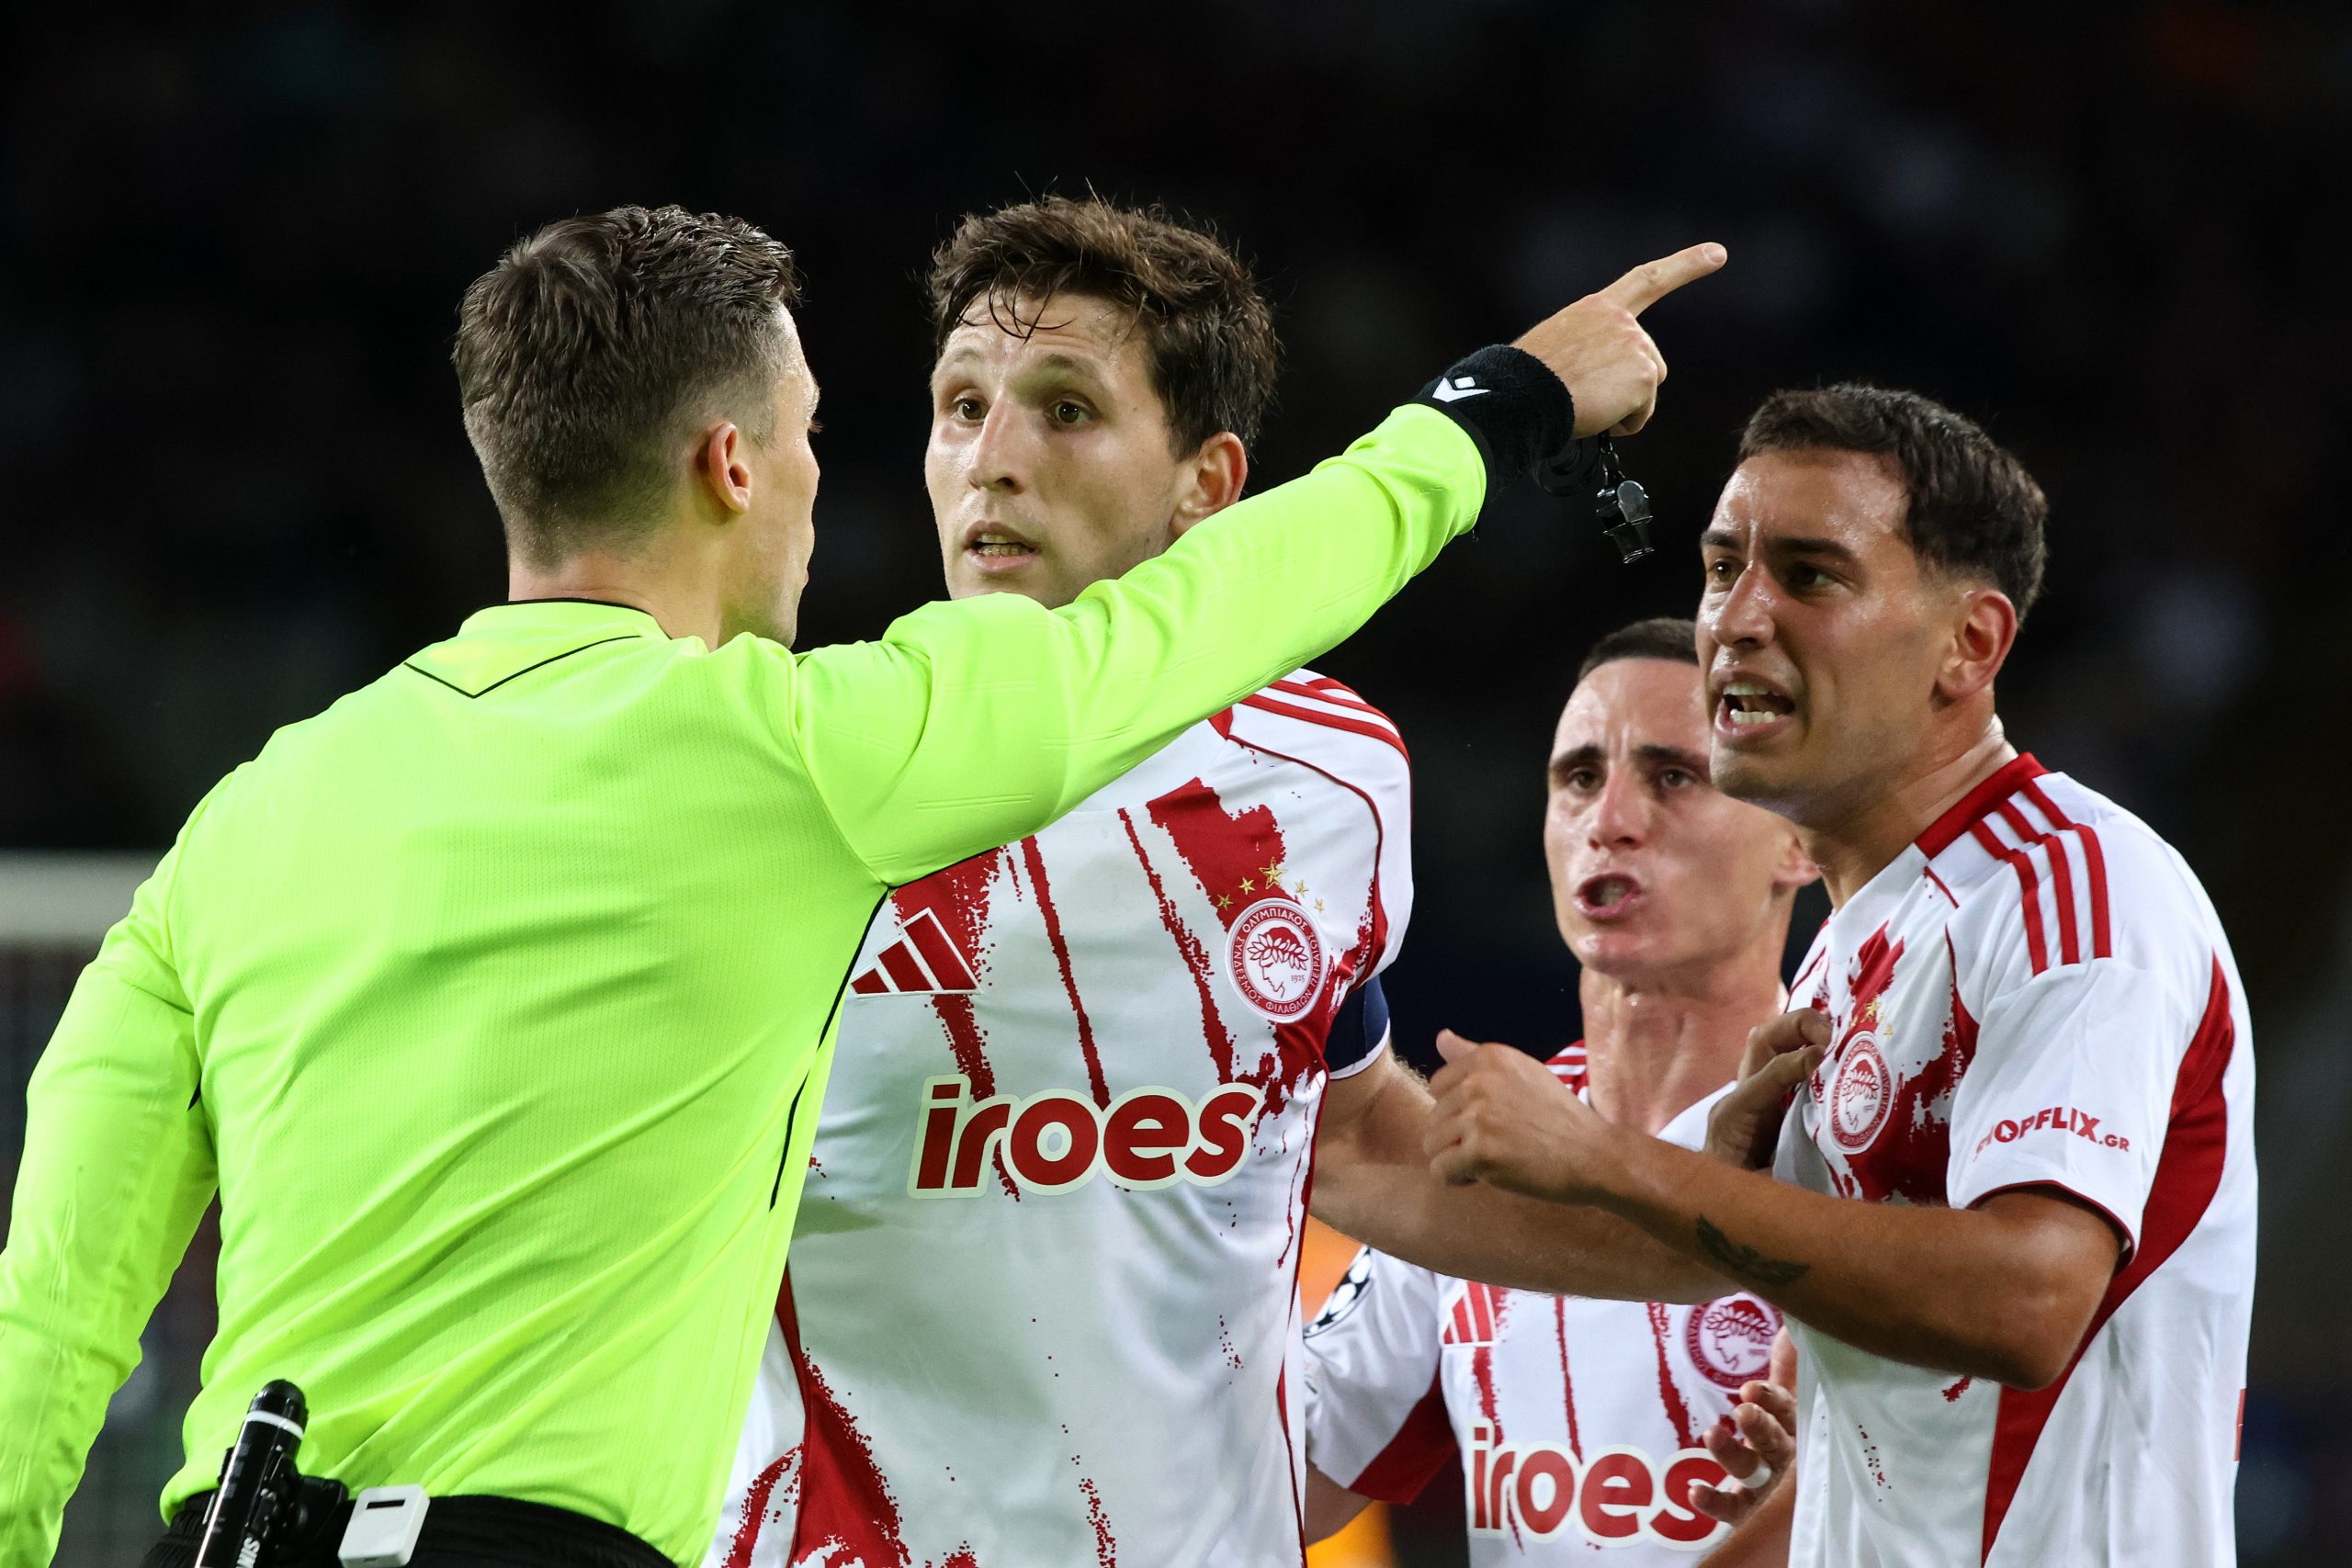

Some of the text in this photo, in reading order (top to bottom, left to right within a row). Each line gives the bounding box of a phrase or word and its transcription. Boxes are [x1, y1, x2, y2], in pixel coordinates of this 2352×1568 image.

[1242, 908, 1308, 933] ΟΛΥΜΠΙΑΚΟΣ
[1233, 936, 1263, 1005] ΣΥΝΔΕΣΜΟΣ
[1265, 990, 1312, 1012] ΦΙΛΑΘΛΩΝ
[1291, 975, 1305, 983] 1925
[916, 1083, 1258, 1188] iroes
[1474, 1427, 1728, 1541] iroes
